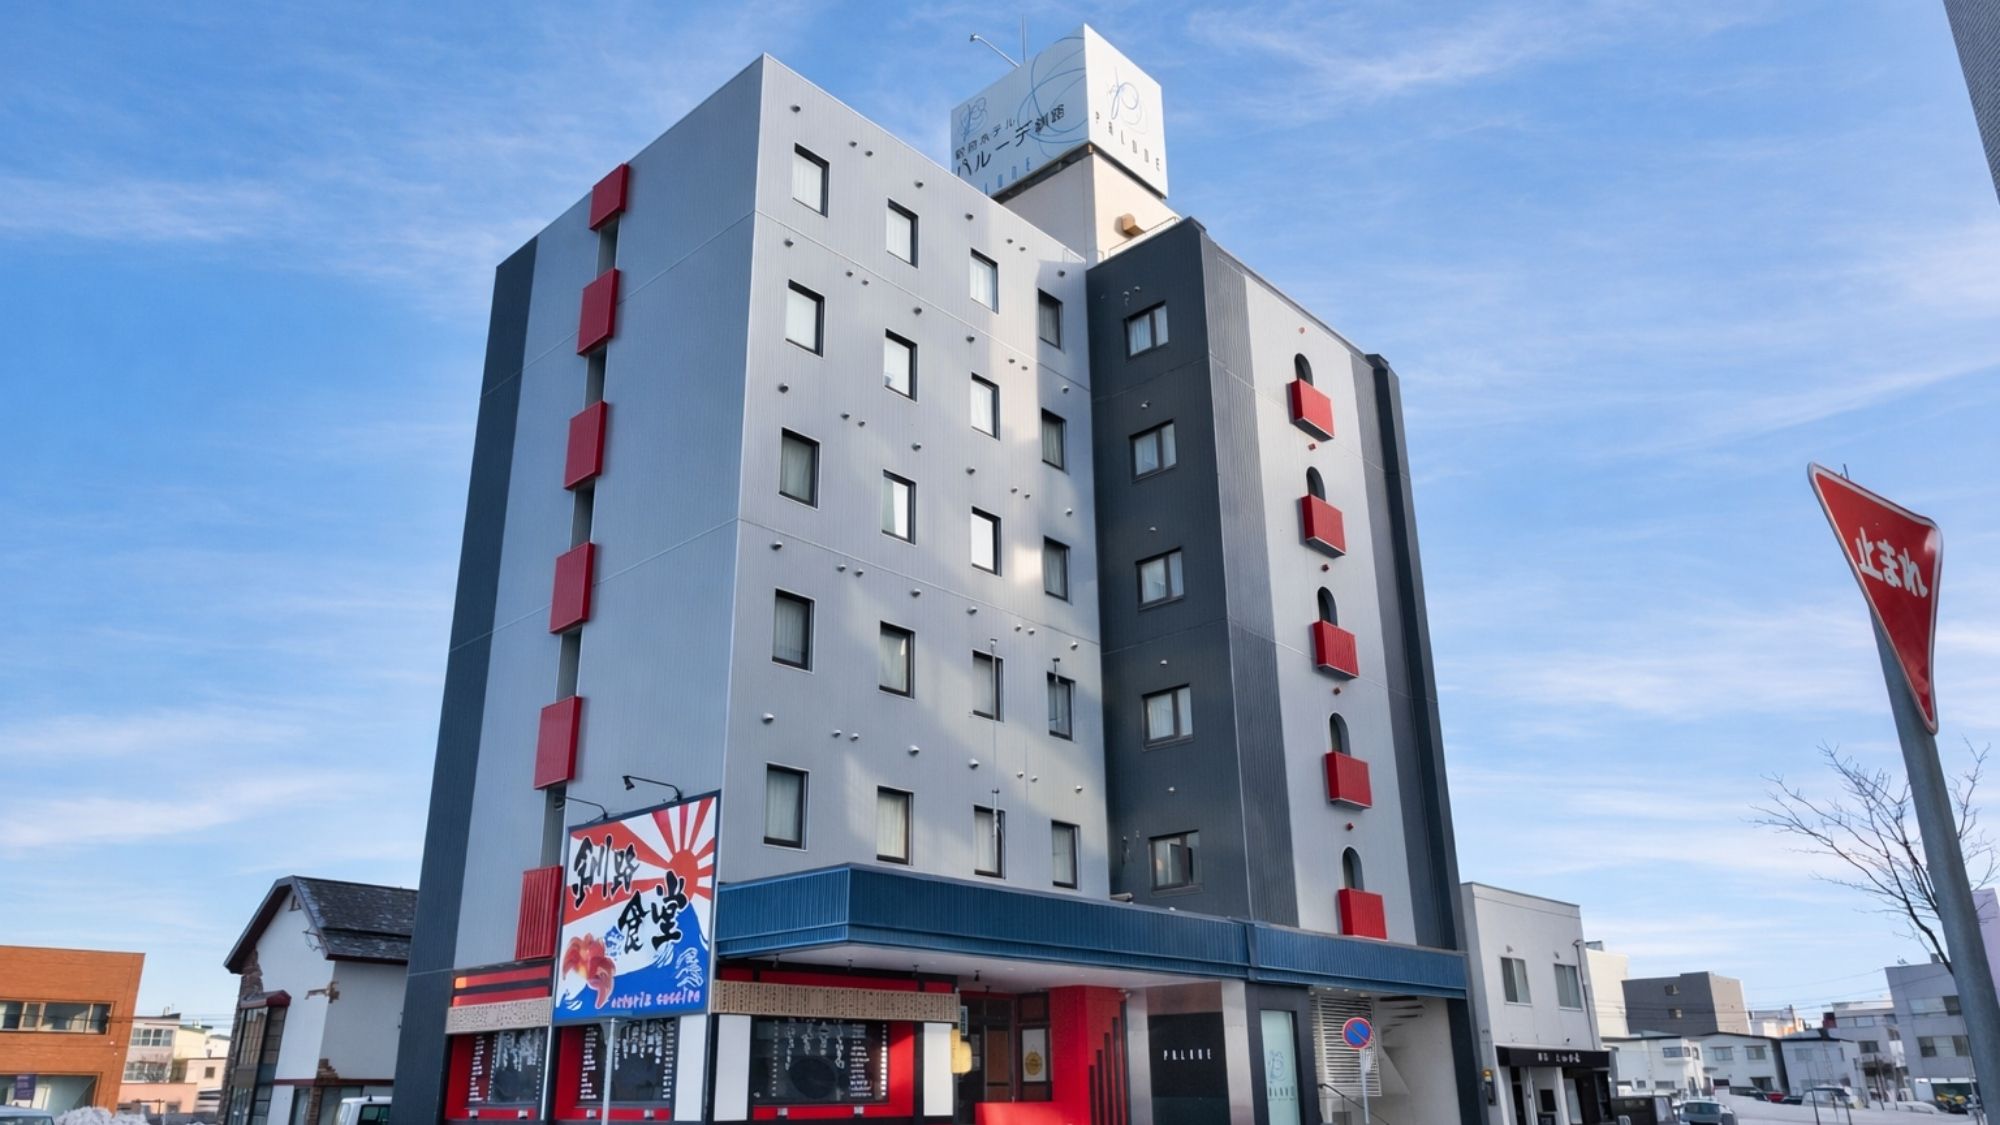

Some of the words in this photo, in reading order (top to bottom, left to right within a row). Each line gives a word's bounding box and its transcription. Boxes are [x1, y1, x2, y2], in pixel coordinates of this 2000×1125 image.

[1854, 526, 1928, 598] 止まれ
[573, 836, 640, 908] 釧路
[617, 871, 689, 953] 食堂
